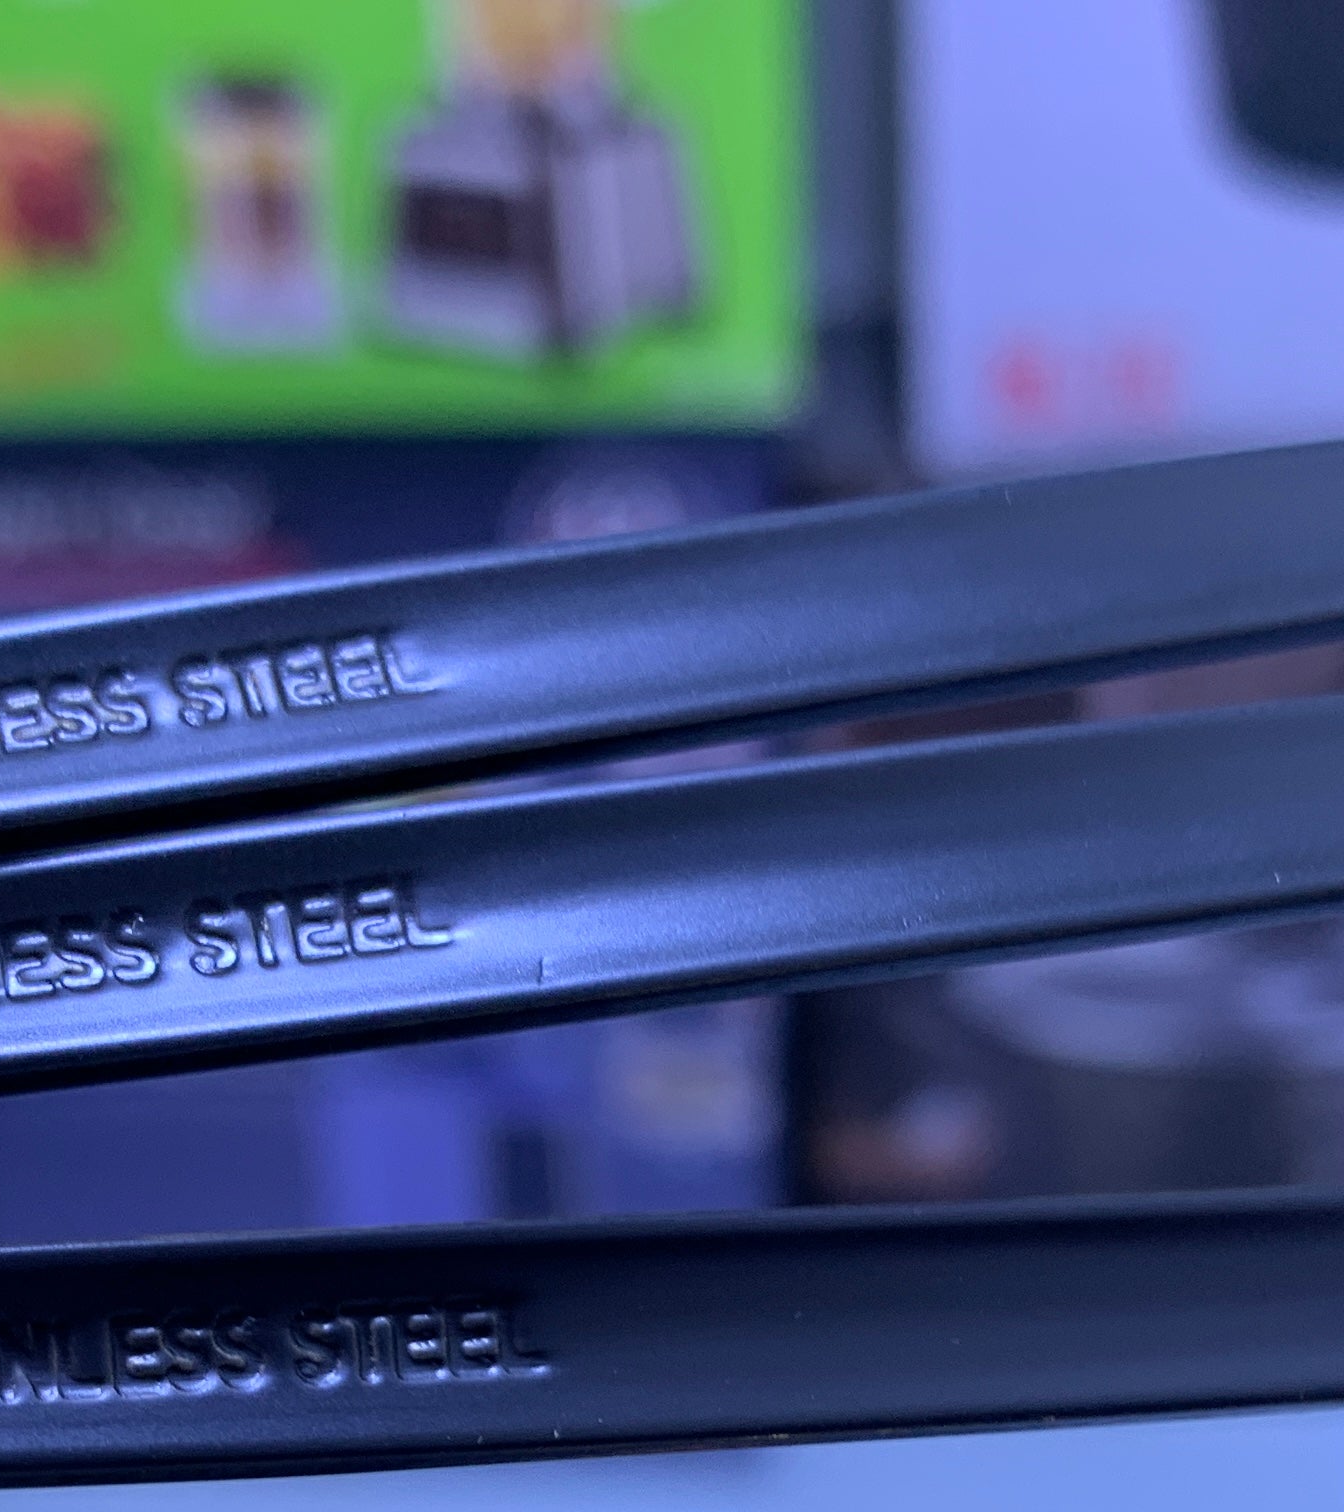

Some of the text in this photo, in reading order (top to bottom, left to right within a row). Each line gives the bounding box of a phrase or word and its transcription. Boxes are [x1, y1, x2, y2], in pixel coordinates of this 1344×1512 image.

[170, 630, 440, 728] STEEL
[184, 874, 456, 977] STEEL
[290, 1303, 553, 1388] STEEL
